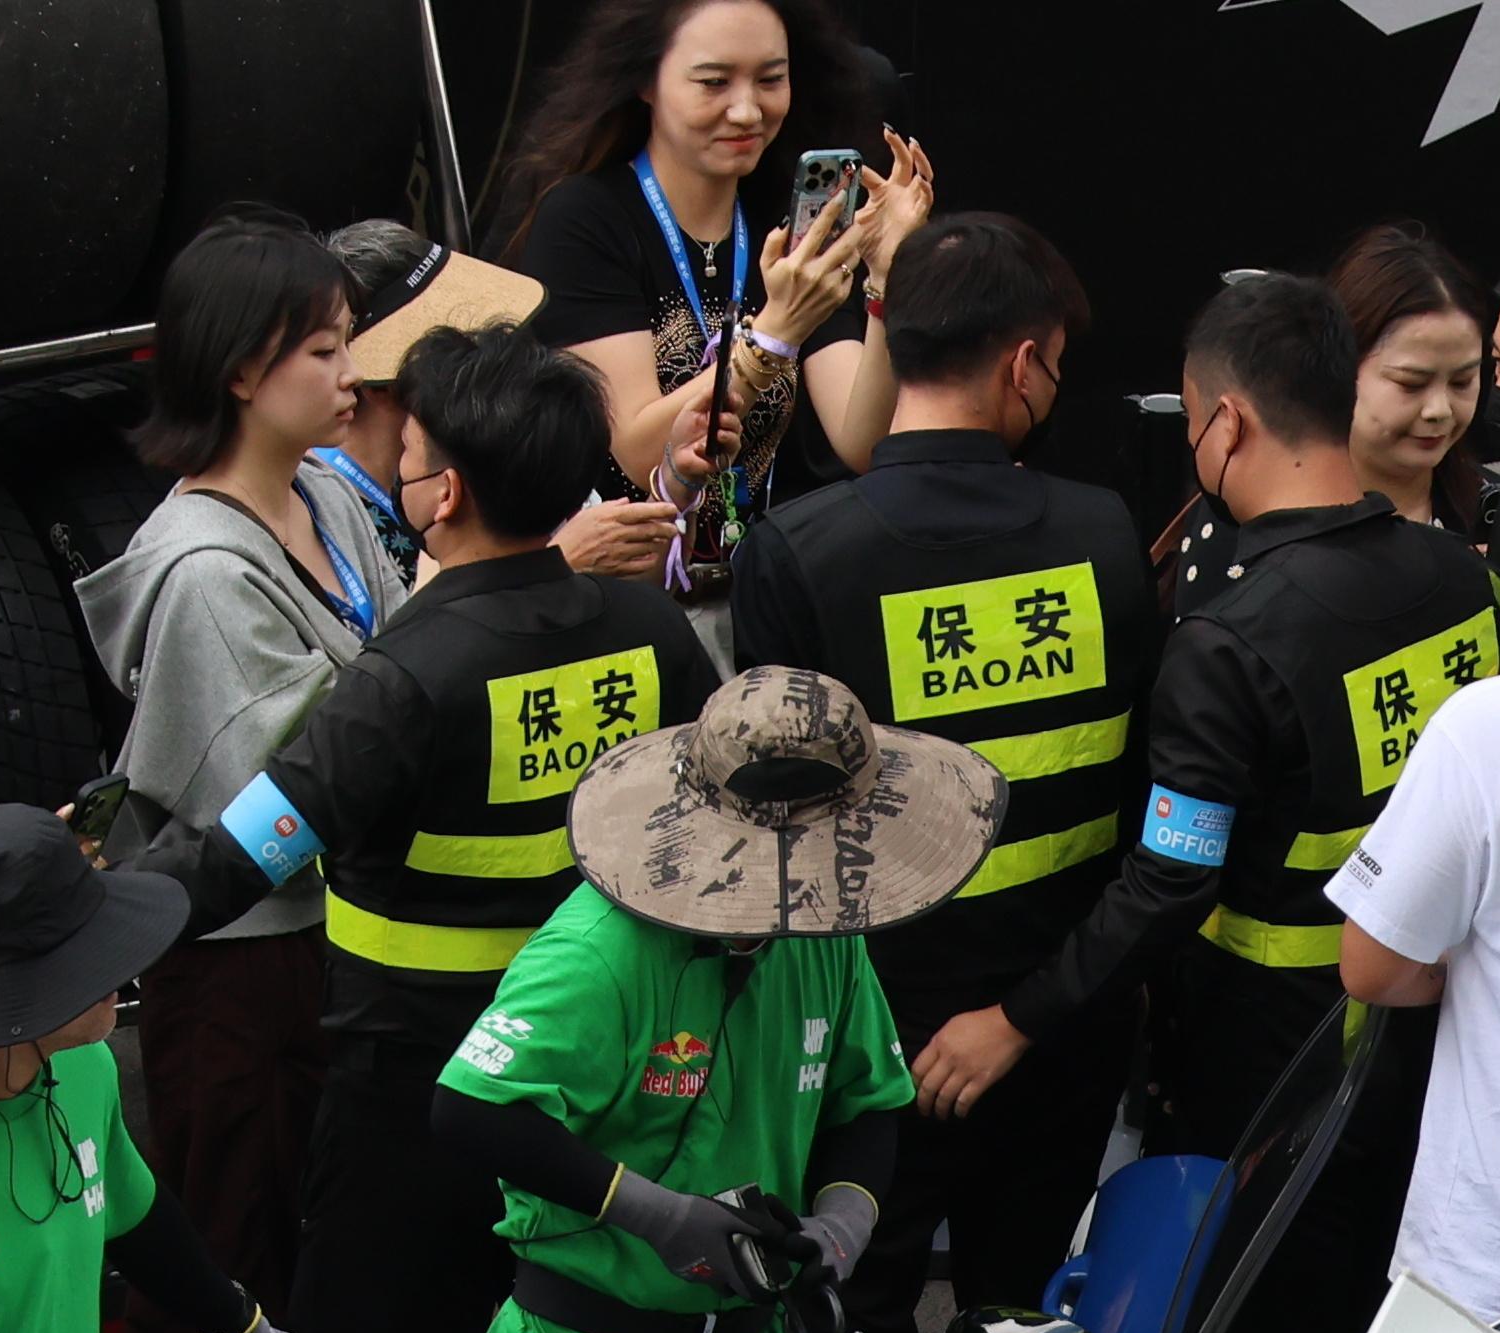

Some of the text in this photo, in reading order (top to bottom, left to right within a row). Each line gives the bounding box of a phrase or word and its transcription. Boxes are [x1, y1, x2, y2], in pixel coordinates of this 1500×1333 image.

[916, 587, 1072, 664] 保安
[922, 646, 1075, 698] BAOAN
[1372, 637, 1482, 733] 保安
[517, 668, 638, 747] 保安
[1156, 826, 1229, 859] OFFICI
[642, 1066, 674, 1096] Red
